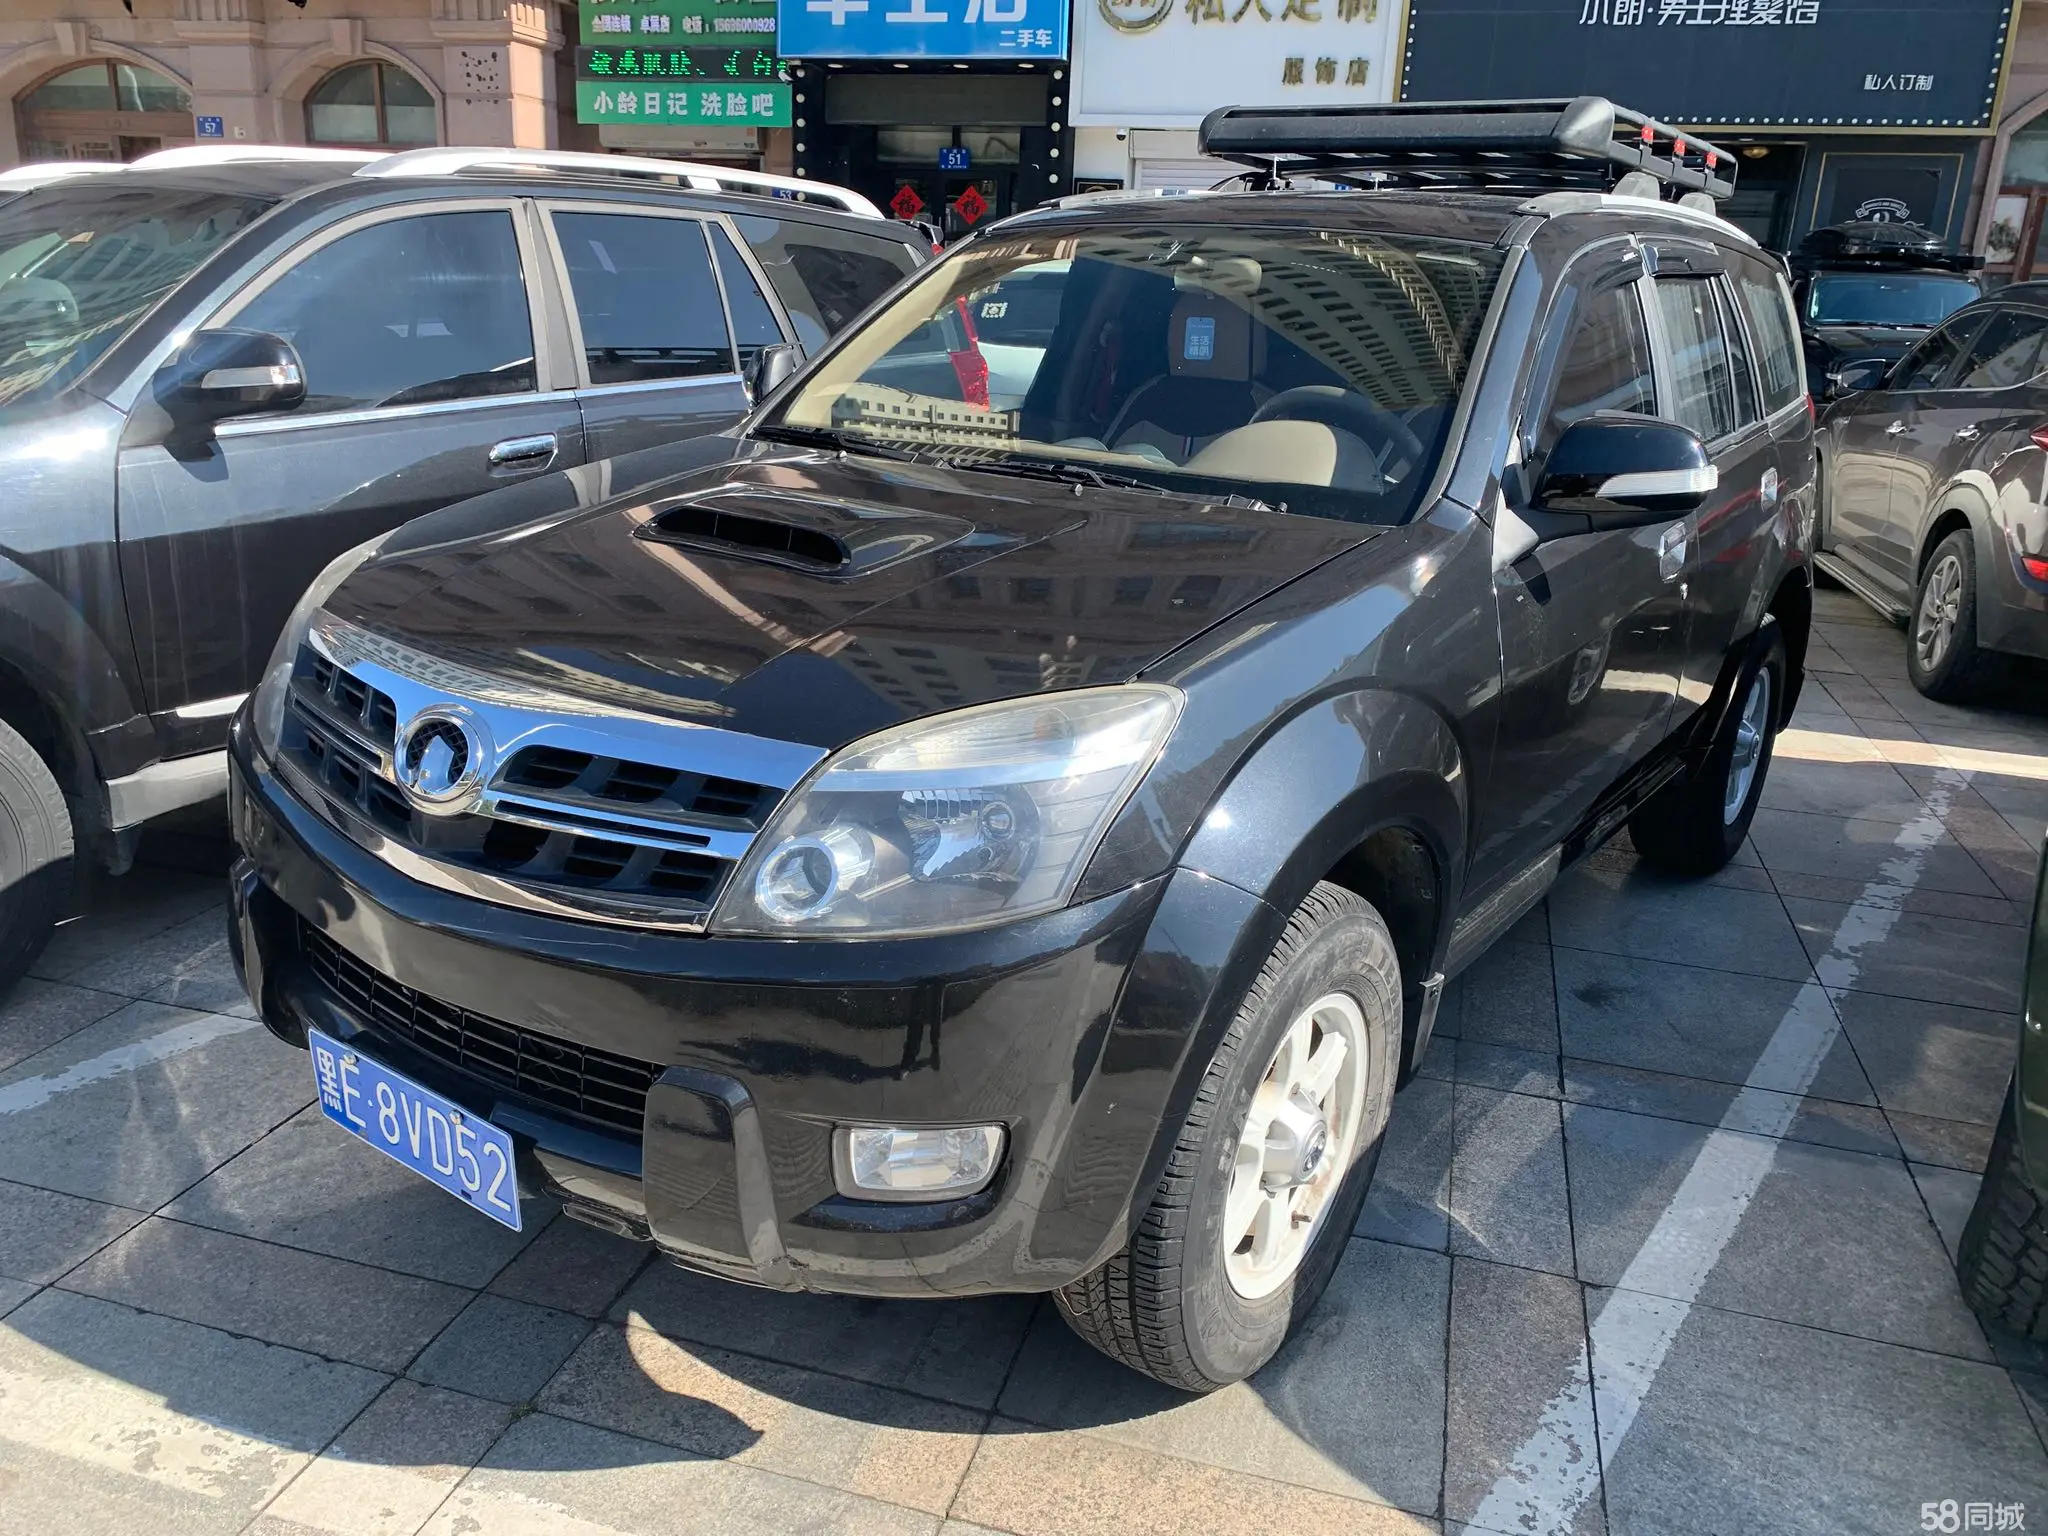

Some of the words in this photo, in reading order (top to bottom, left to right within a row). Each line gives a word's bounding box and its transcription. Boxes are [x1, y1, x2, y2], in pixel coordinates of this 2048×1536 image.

[999, 29, 1053, 48] 二手车
[1281, 57, 1370, 85] 服饰店
[1863, 74, 1934, 91] 私人订制
[593, 91, 688, 116] 小龄日记
[701, 91, 774, 117] 洗脸吧
[204, 122, 216, 133] 57
[948, 153, 961, 165] 51
